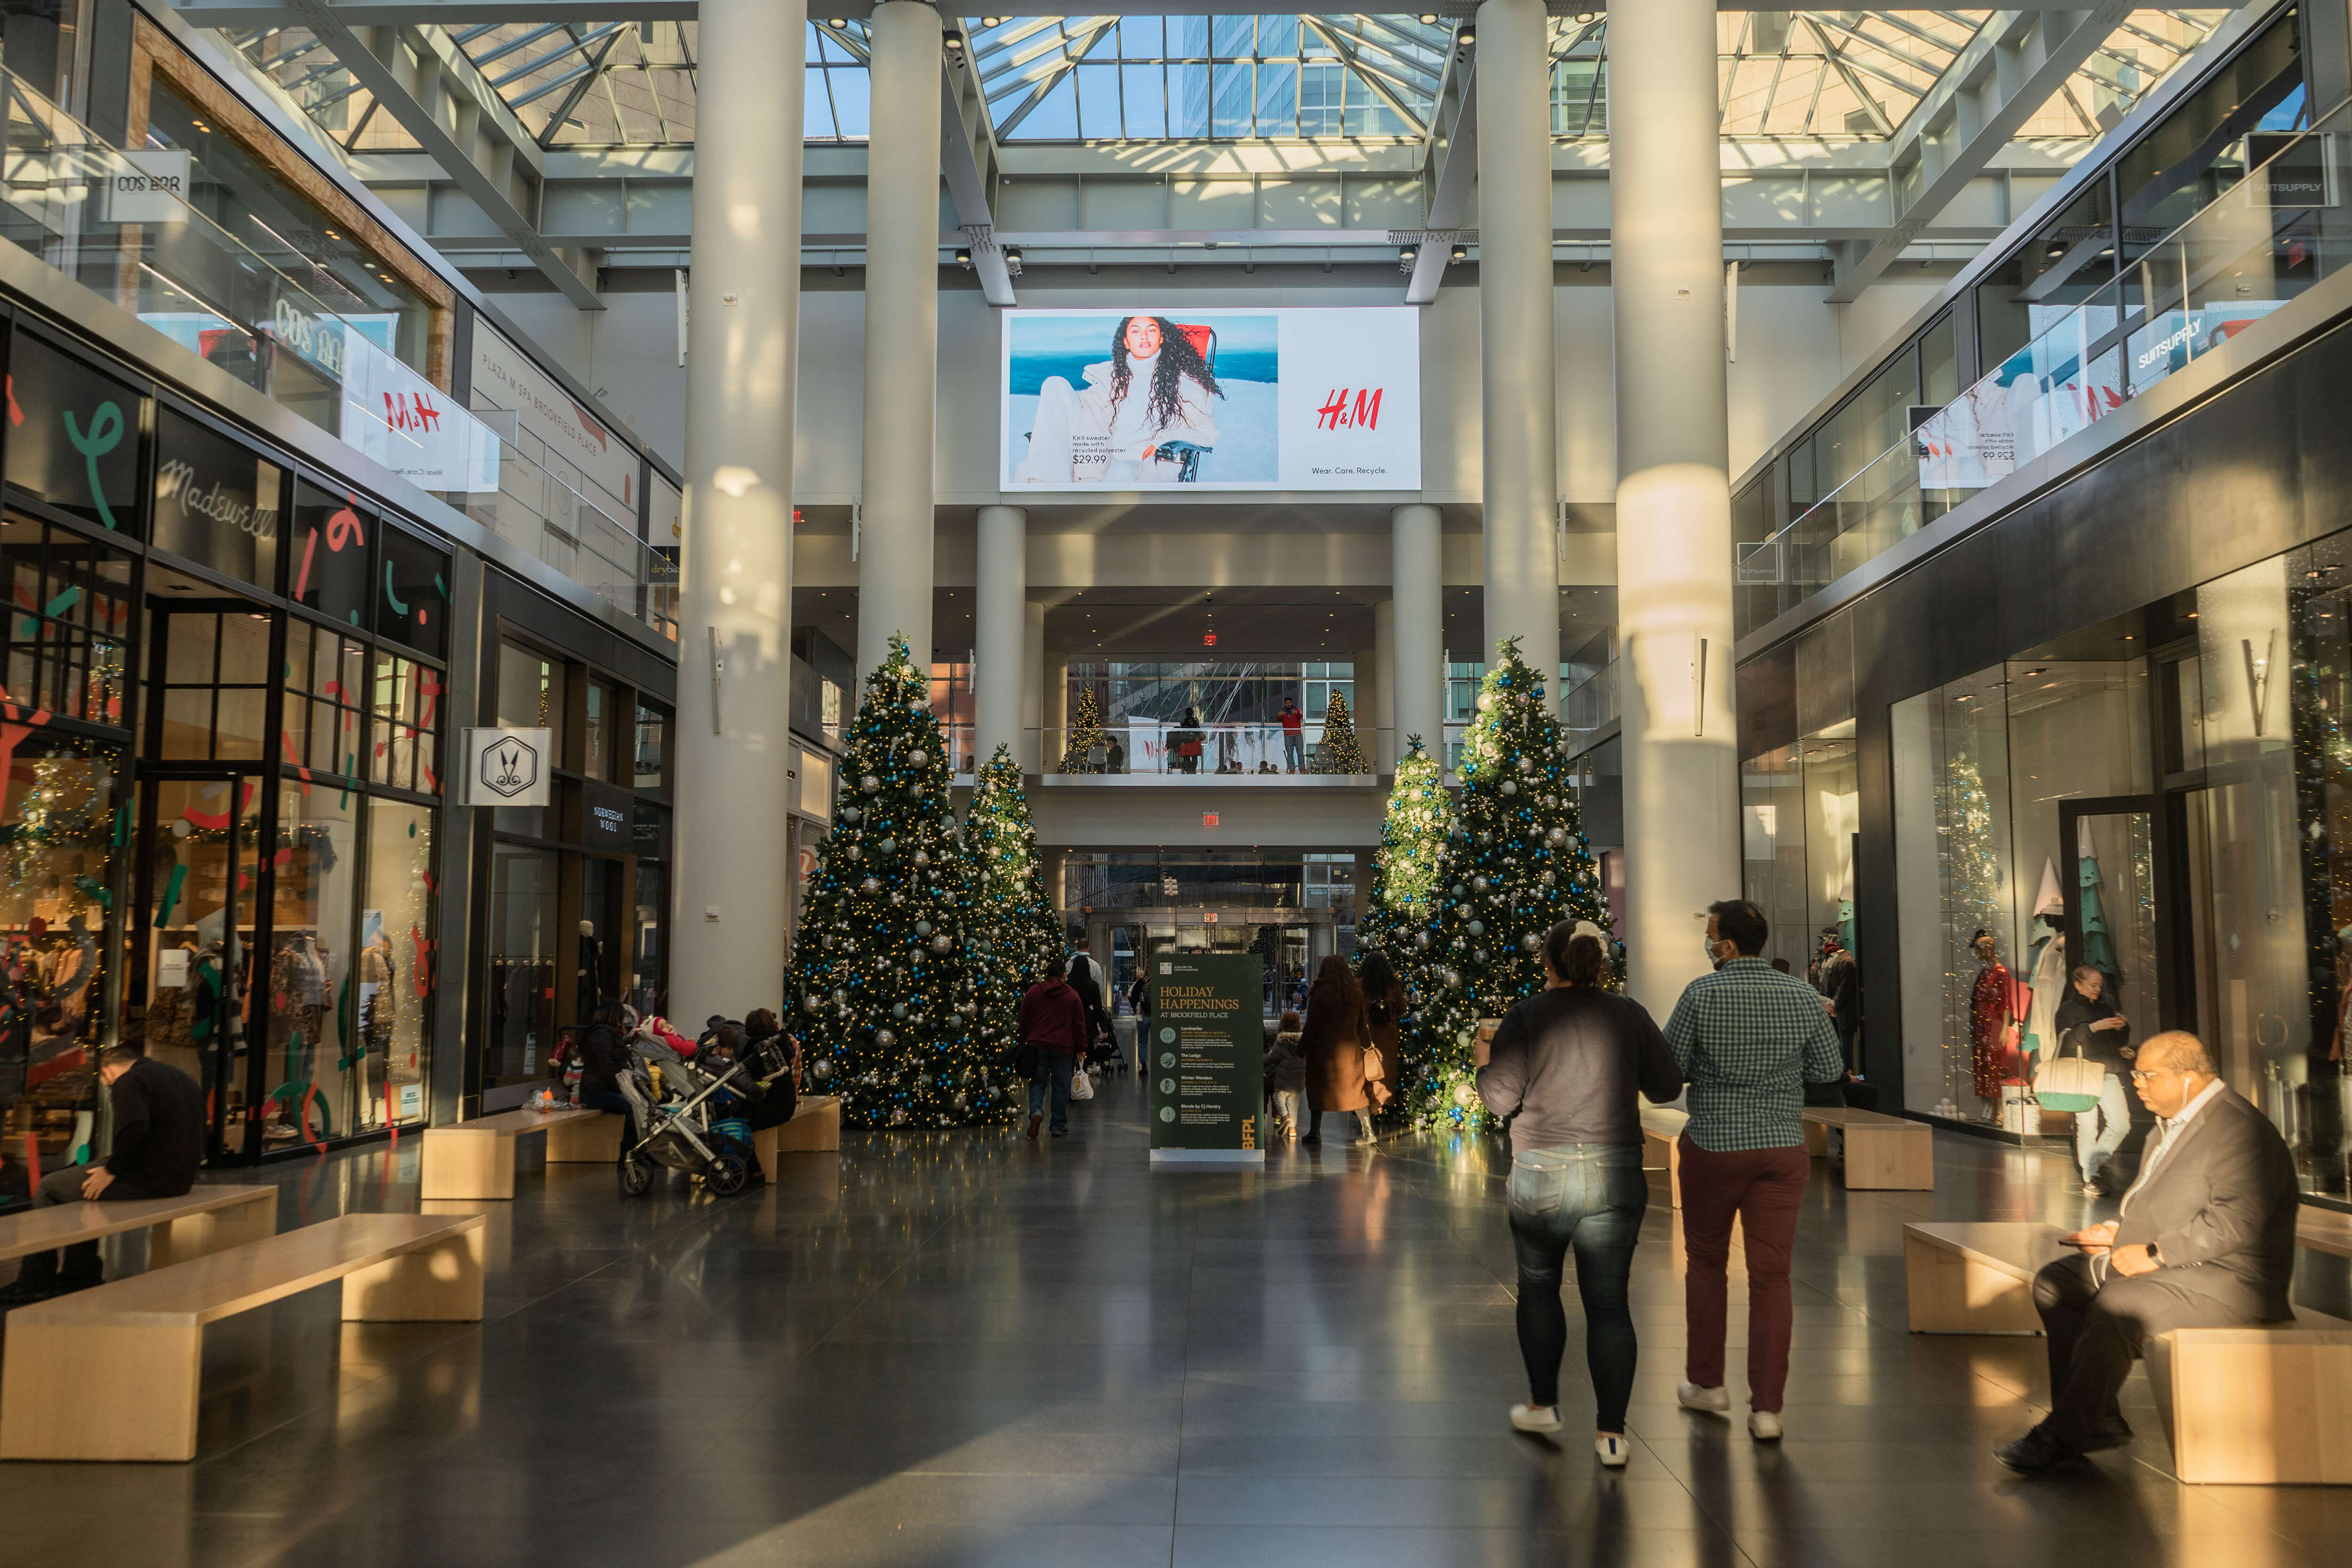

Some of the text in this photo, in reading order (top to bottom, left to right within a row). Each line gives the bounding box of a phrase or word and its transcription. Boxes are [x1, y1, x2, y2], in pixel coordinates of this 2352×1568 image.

[118, 176, 146, 191] COS
[275, 299, 314, 354] COS
[2138, 318, 2201, 369] SUITSUPPLY
[483, 354, 597, 457] PLAZA M SPA BROOKFIELD PLACE
[1317, 388, 1383, 431] H&M
[1073, 454, 1106, 464] $29.99
[161, 459, 274, 541] Madewell
[594, 806, 623, 821] NORWEGIAN
[1160, 987, 1214, 997] HOLIDAY
[1160, 999, 1239, 1010] HAPPENINGS
[1242, 1115, 1255, 1149] BFPL
